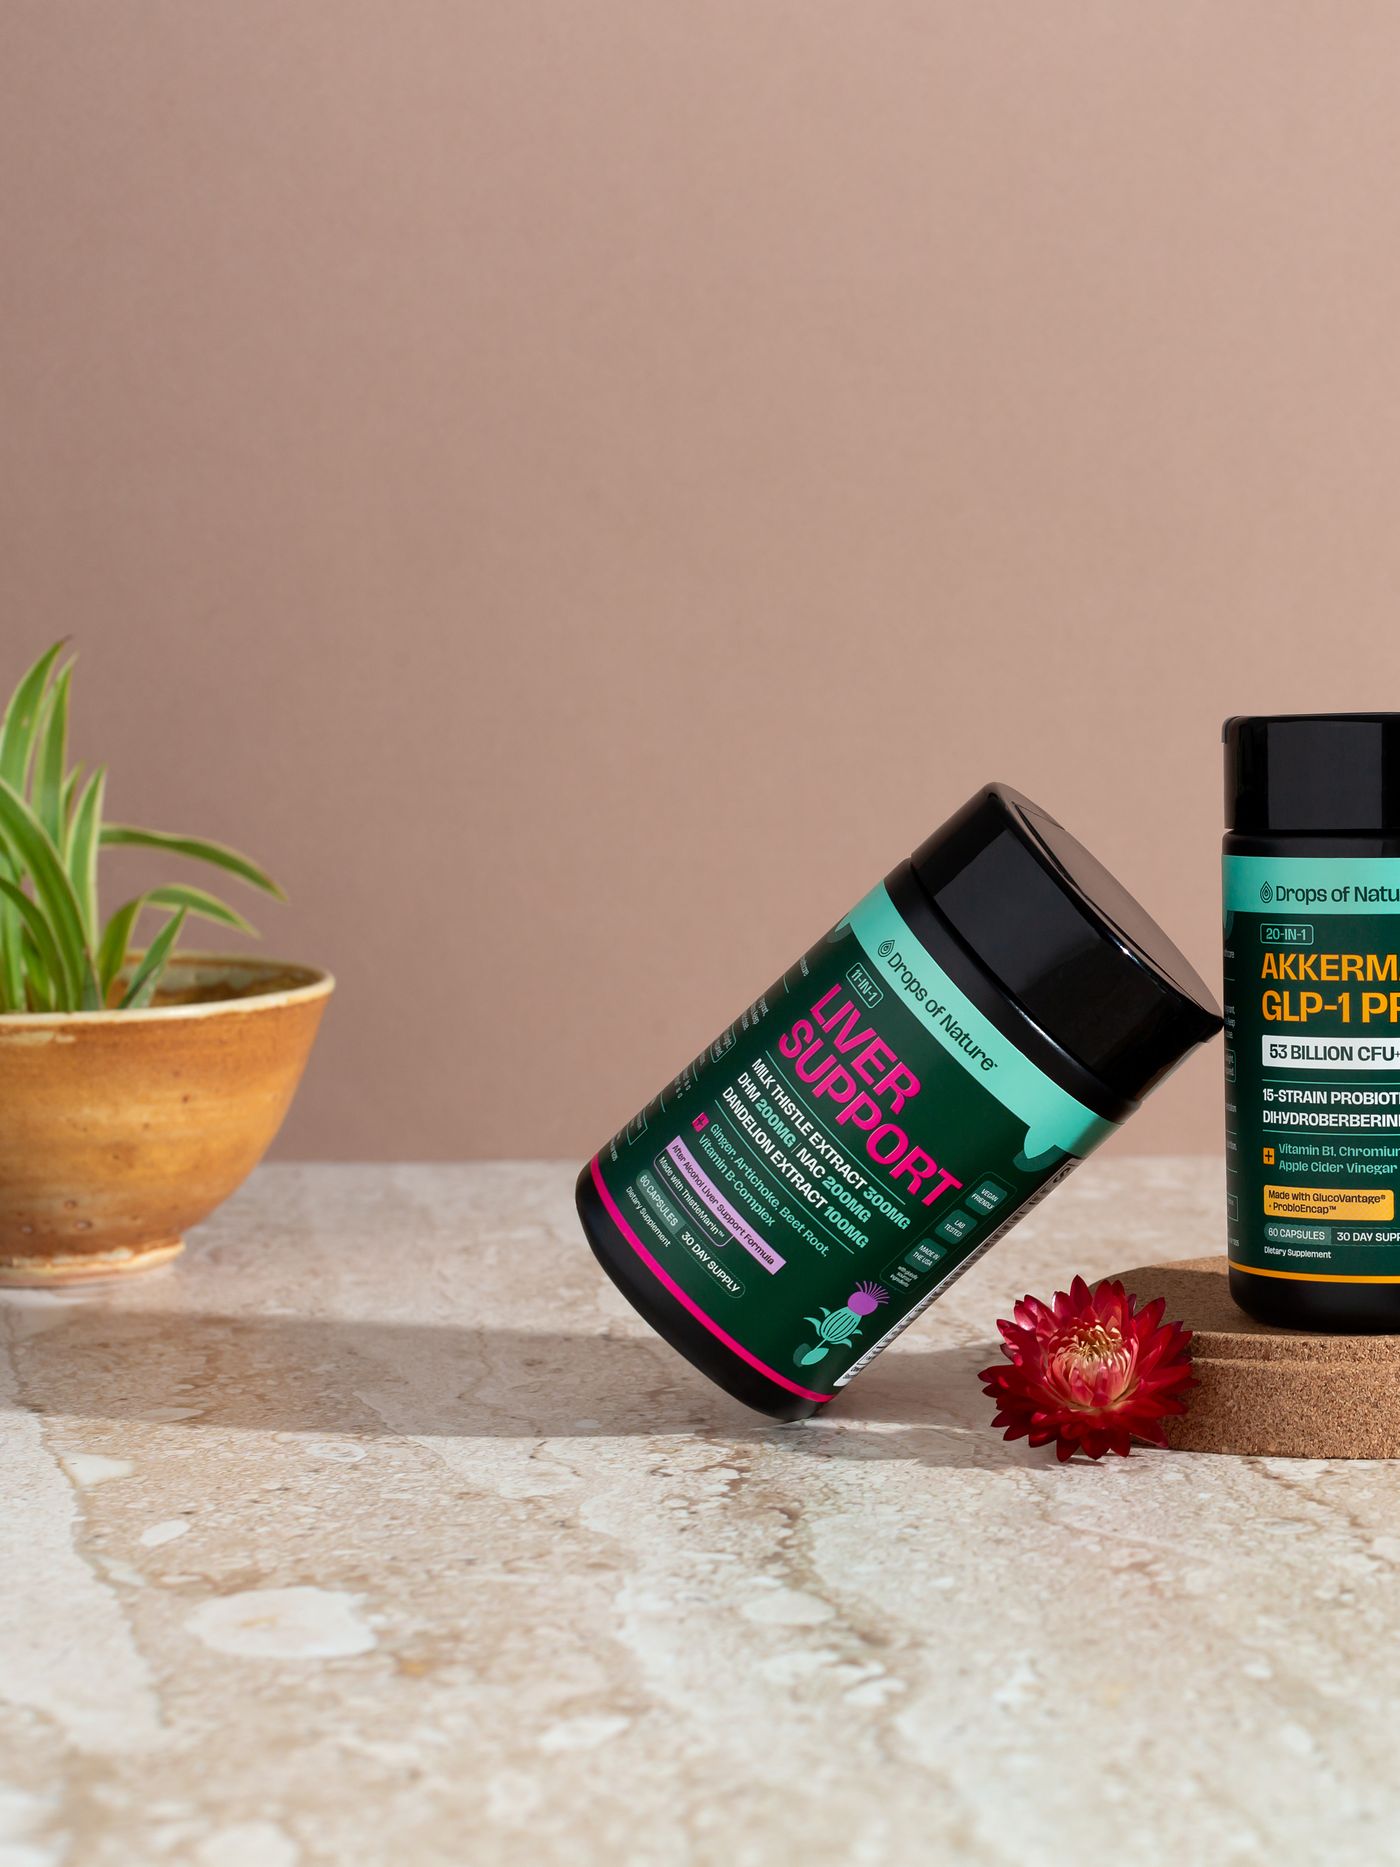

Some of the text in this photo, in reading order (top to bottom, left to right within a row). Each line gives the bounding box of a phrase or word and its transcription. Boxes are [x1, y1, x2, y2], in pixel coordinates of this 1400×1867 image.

[1276, 886, 1327, 905] Drops
[1332, 887, 1350, 902] of
[1266, 928, 1306, 941] 20-IN-1
[850, 969, 877, 1002] 11-IN-1
[886, 951, 928, 1002] Drops
[923, 997, 947, 1018] of
[1261, 990, 1350, 1022] GLP-1
[809, 983, 923, 1115] LIVER
[1270, 1044, 1400, 1062] 53 BILLION CFU+
[1263, 1088, 1327, 1104] 15-STRAIN
[776, 1018, 963, 1206] SUPPORT
[736, 1071, 872, 1223] DHM 200MG NAC 200MG
[750, 1057, 911, 1230] MILK THISTLE EXTRACT 300MG
[1278, 1144, 1320, 1156] Vitamin
[658, 1155, 673, 1177] Made
[669, 1173, 684, 1191] with
[721, 1086, 870, 1248] DANDELION EXTRACT 100MG
[1279, 1160, 1398, 1175] Apple Cider Vinegar
[699, 1133, 775, 1227] Vitamin B-Complex
[671, 1144, 775, 1265] After Alcohol Liver Support Formula
[971, 1192, 995, 1210] FRIENDLY
[980, 1188, 999, 1202] VEGAN
[1268, 1190, 1290, 1200] Made
[1292, 1192, 1310, 1202] with
[625, 1185, 671, 1247] Dietary Supplement
[778, 1206, 806, 1233] Beet
[953, 1219, 966, 1229] LAB
[639, 1174, 740, 1292] 60 CAPSULES 30 DAY SUPPLY
[943, 1223, 962, 1237] TESTED
[1268, 1227, 1279, 1237] 60
[1280, 1228, 1326, 1241] CAPSULES
[1336, 1232, 1350, 1242] 30
[1353, 1232, 1373, 1242] DAY
[912, 1251, 933, 1266] THE USA
[918, 1244, 935, 1257] MADE
[1264, 1246, 1332, 1259] Dietary Supplement
